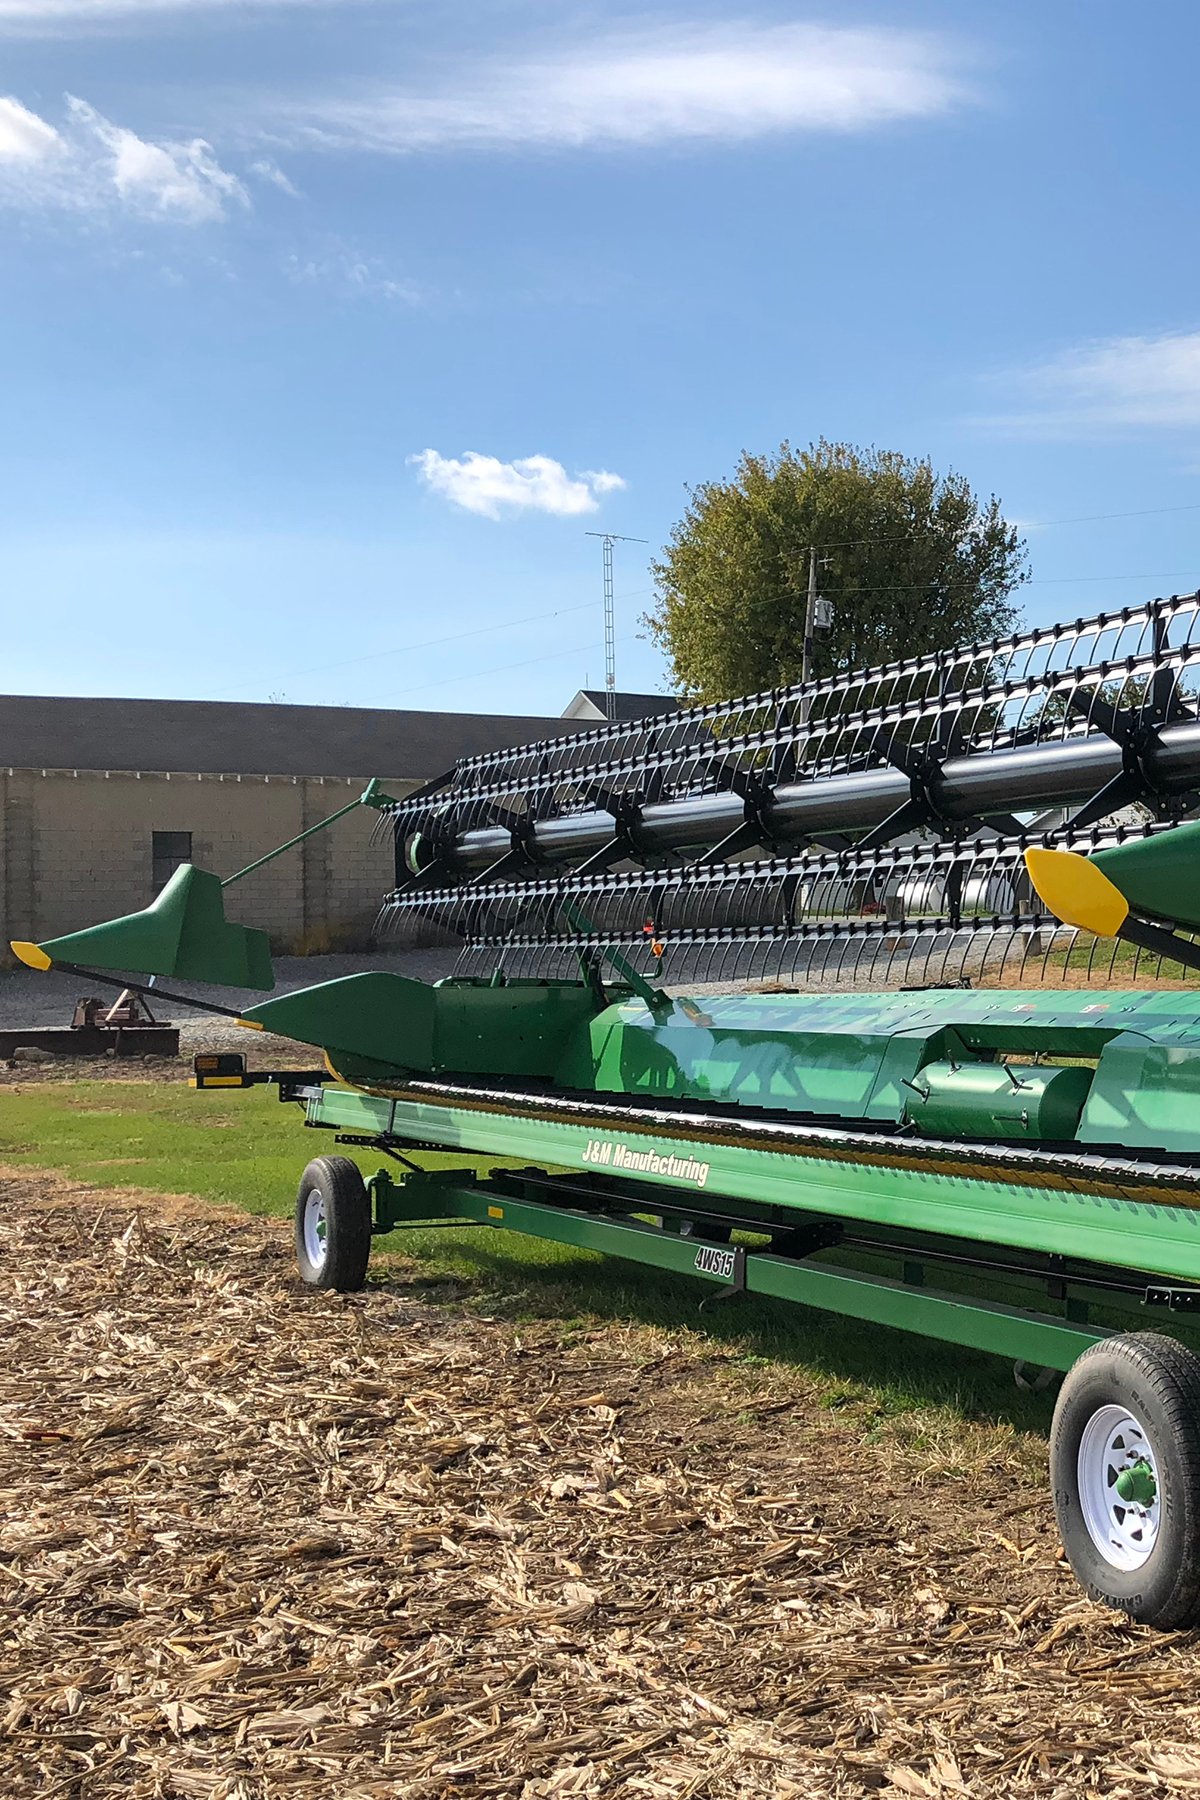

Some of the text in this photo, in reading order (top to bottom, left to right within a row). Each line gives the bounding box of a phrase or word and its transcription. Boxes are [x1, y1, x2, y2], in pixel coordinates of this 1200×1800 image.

[582, 1140, 710, 1187] J&M Manufacturing
[695, 1247, 734, 1277] 4WS15
